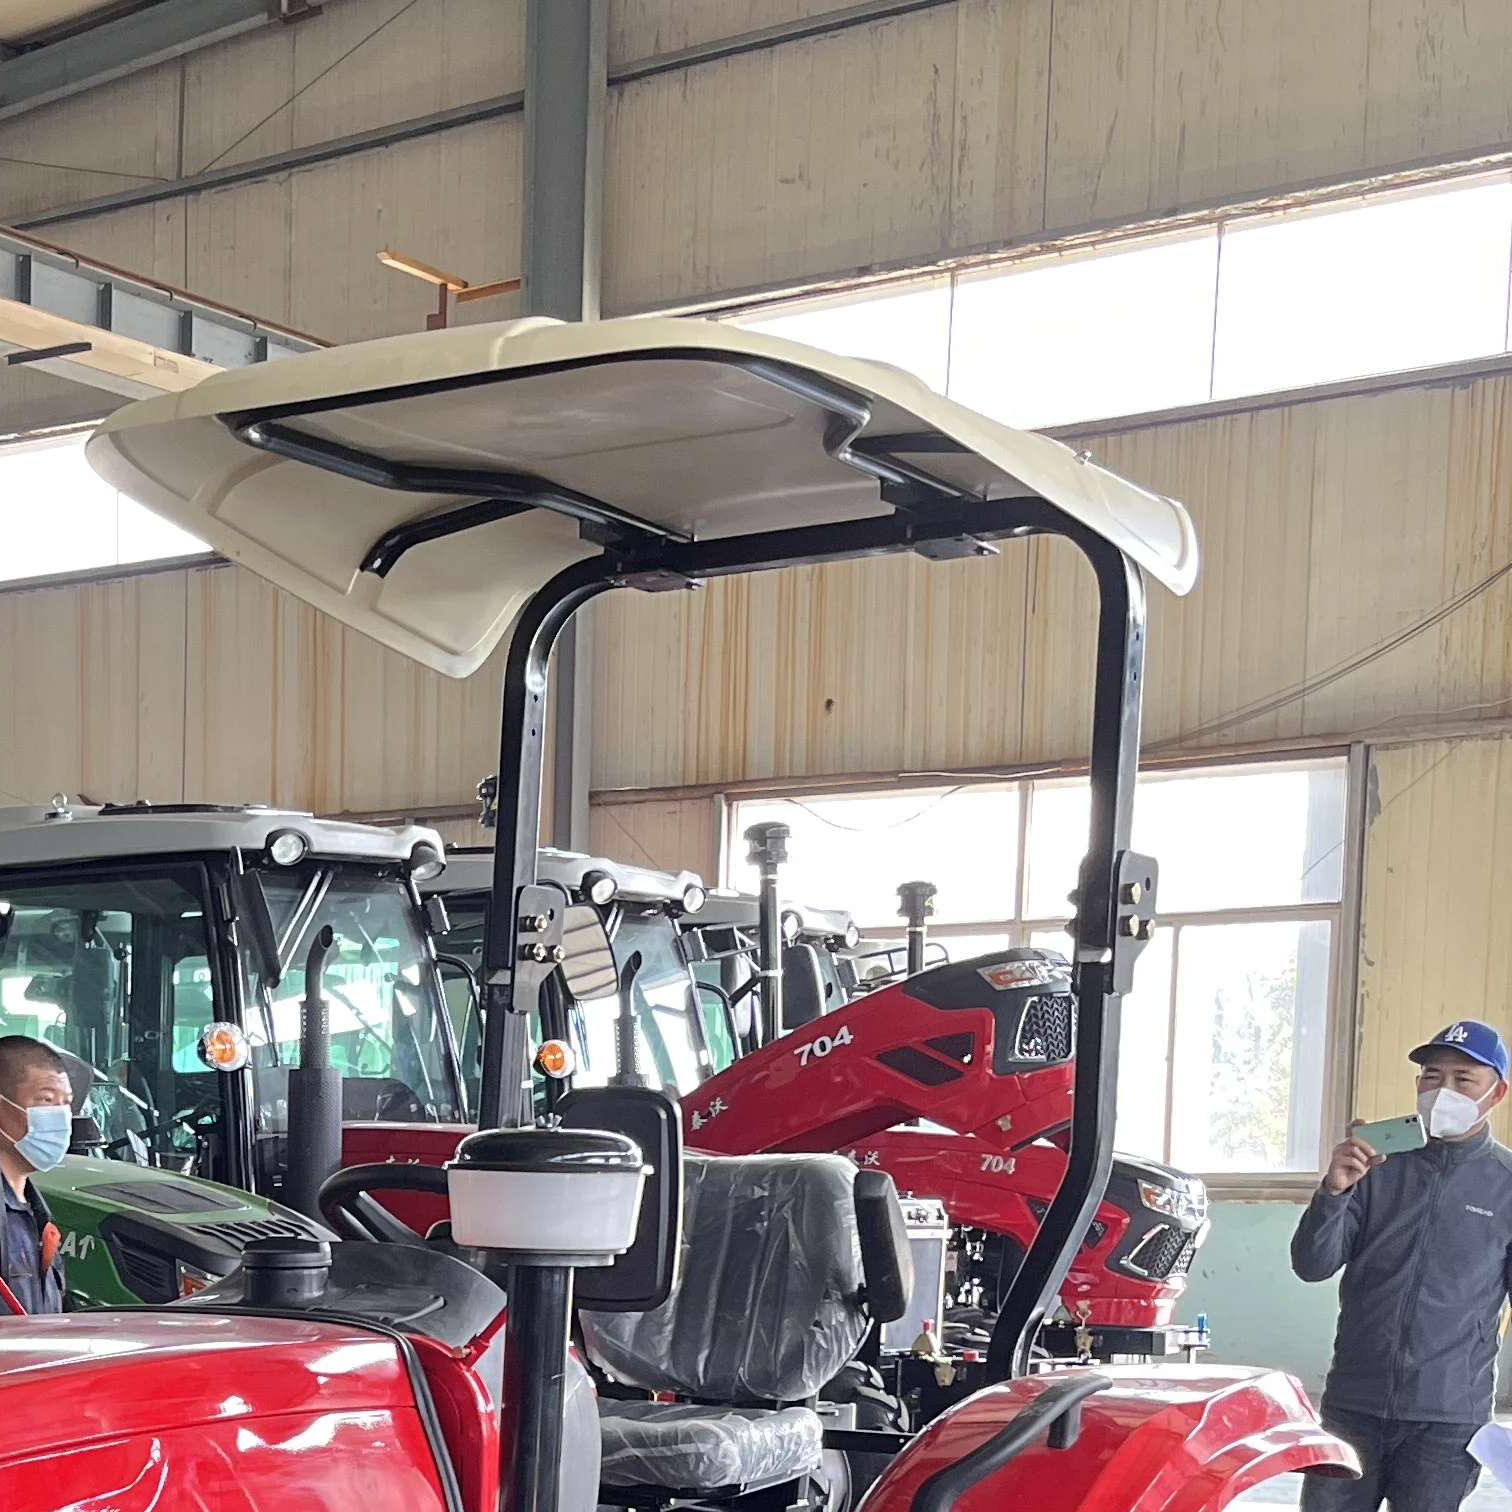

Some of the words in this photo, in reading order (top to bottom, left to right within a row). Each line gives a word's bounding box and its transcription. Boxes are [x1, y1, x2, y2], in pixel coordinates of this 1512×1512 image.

[1444, 1023, 1468, 1043] LA
[794, 1025, 854, 1067] 704
[979, 1153, 1017, 1175] 704
